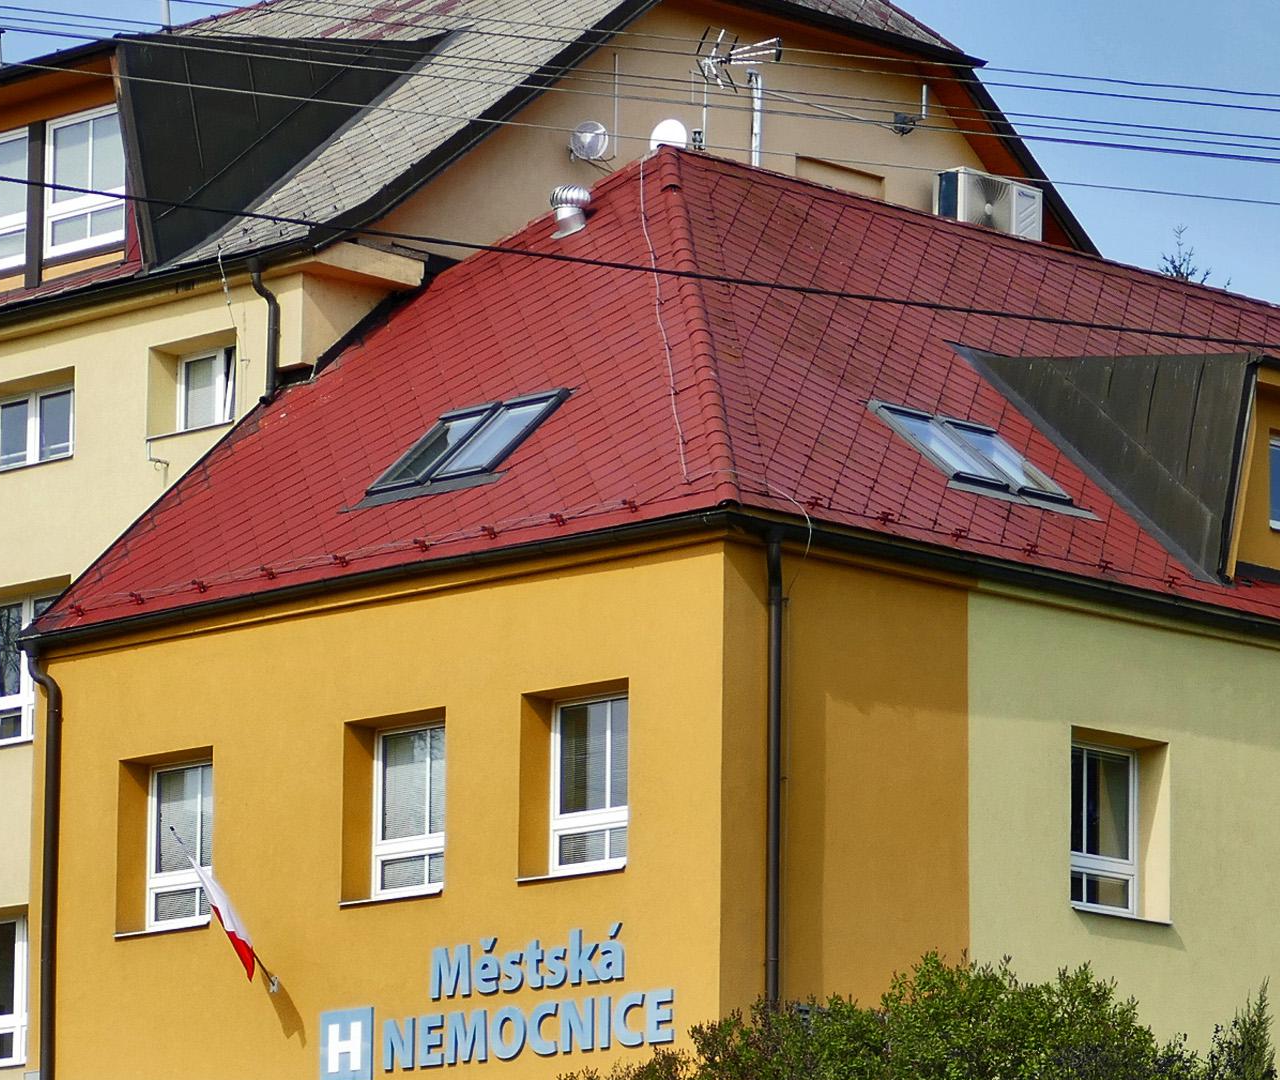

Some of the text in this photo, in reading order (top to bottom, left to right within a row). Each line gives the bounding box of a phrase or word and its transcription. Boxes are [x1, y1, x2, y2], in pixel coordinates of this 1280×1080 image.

[431, 922, 624, 1000] Městská
[328, 1021, 362, 1073] H
[383, 988, 674, 1071] NEMOCNICE
